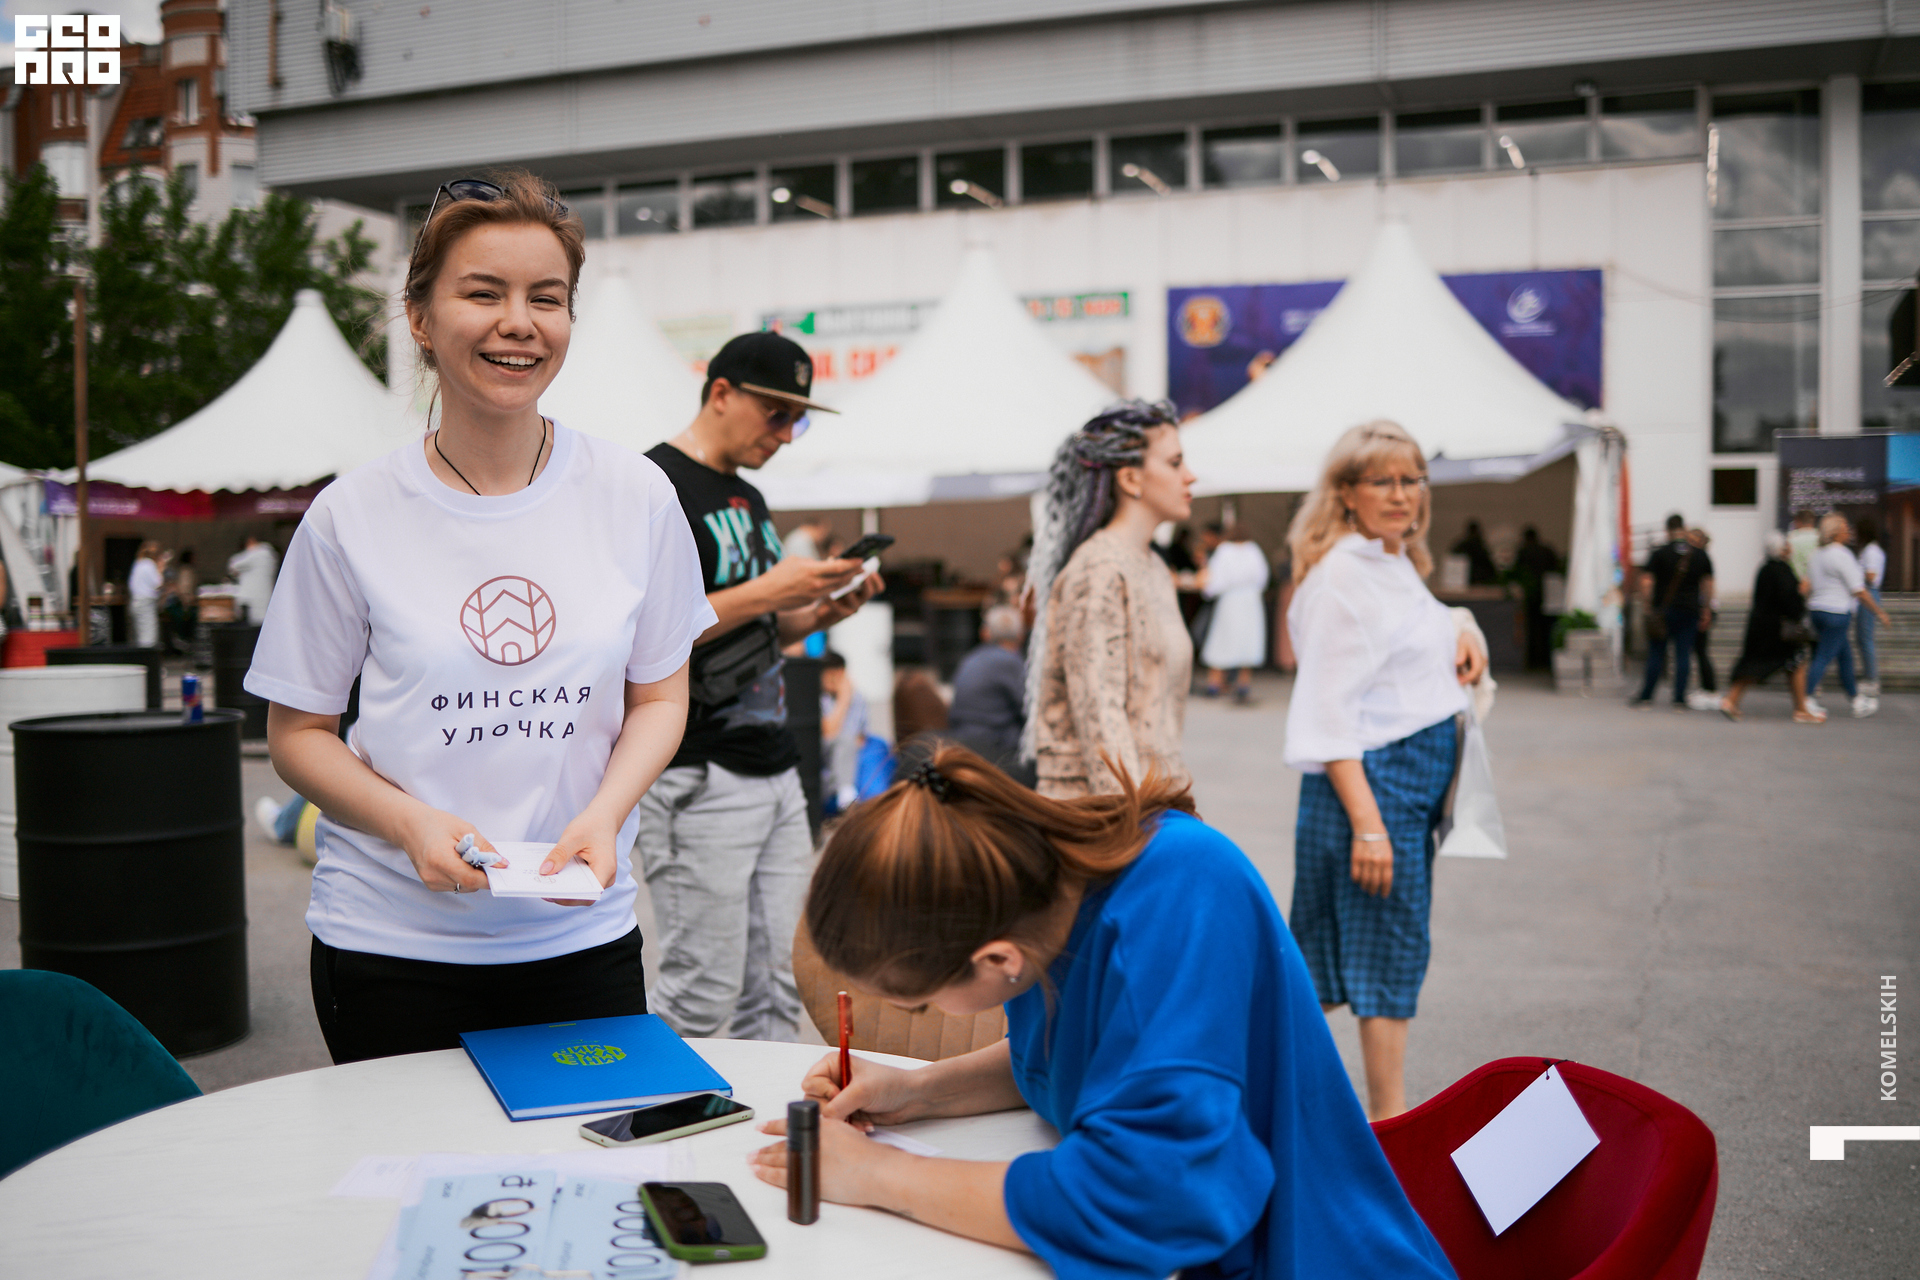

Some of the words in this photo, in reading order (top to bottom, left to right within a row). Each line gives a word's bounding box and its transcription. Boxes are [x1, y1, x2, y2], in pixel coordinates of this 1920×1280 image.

[430, 686, 591, 711] ФИНСКАЯ
[442, 720, 575, 746] УЛОЧКА
[556, 1044, 607, 1055] МИР
